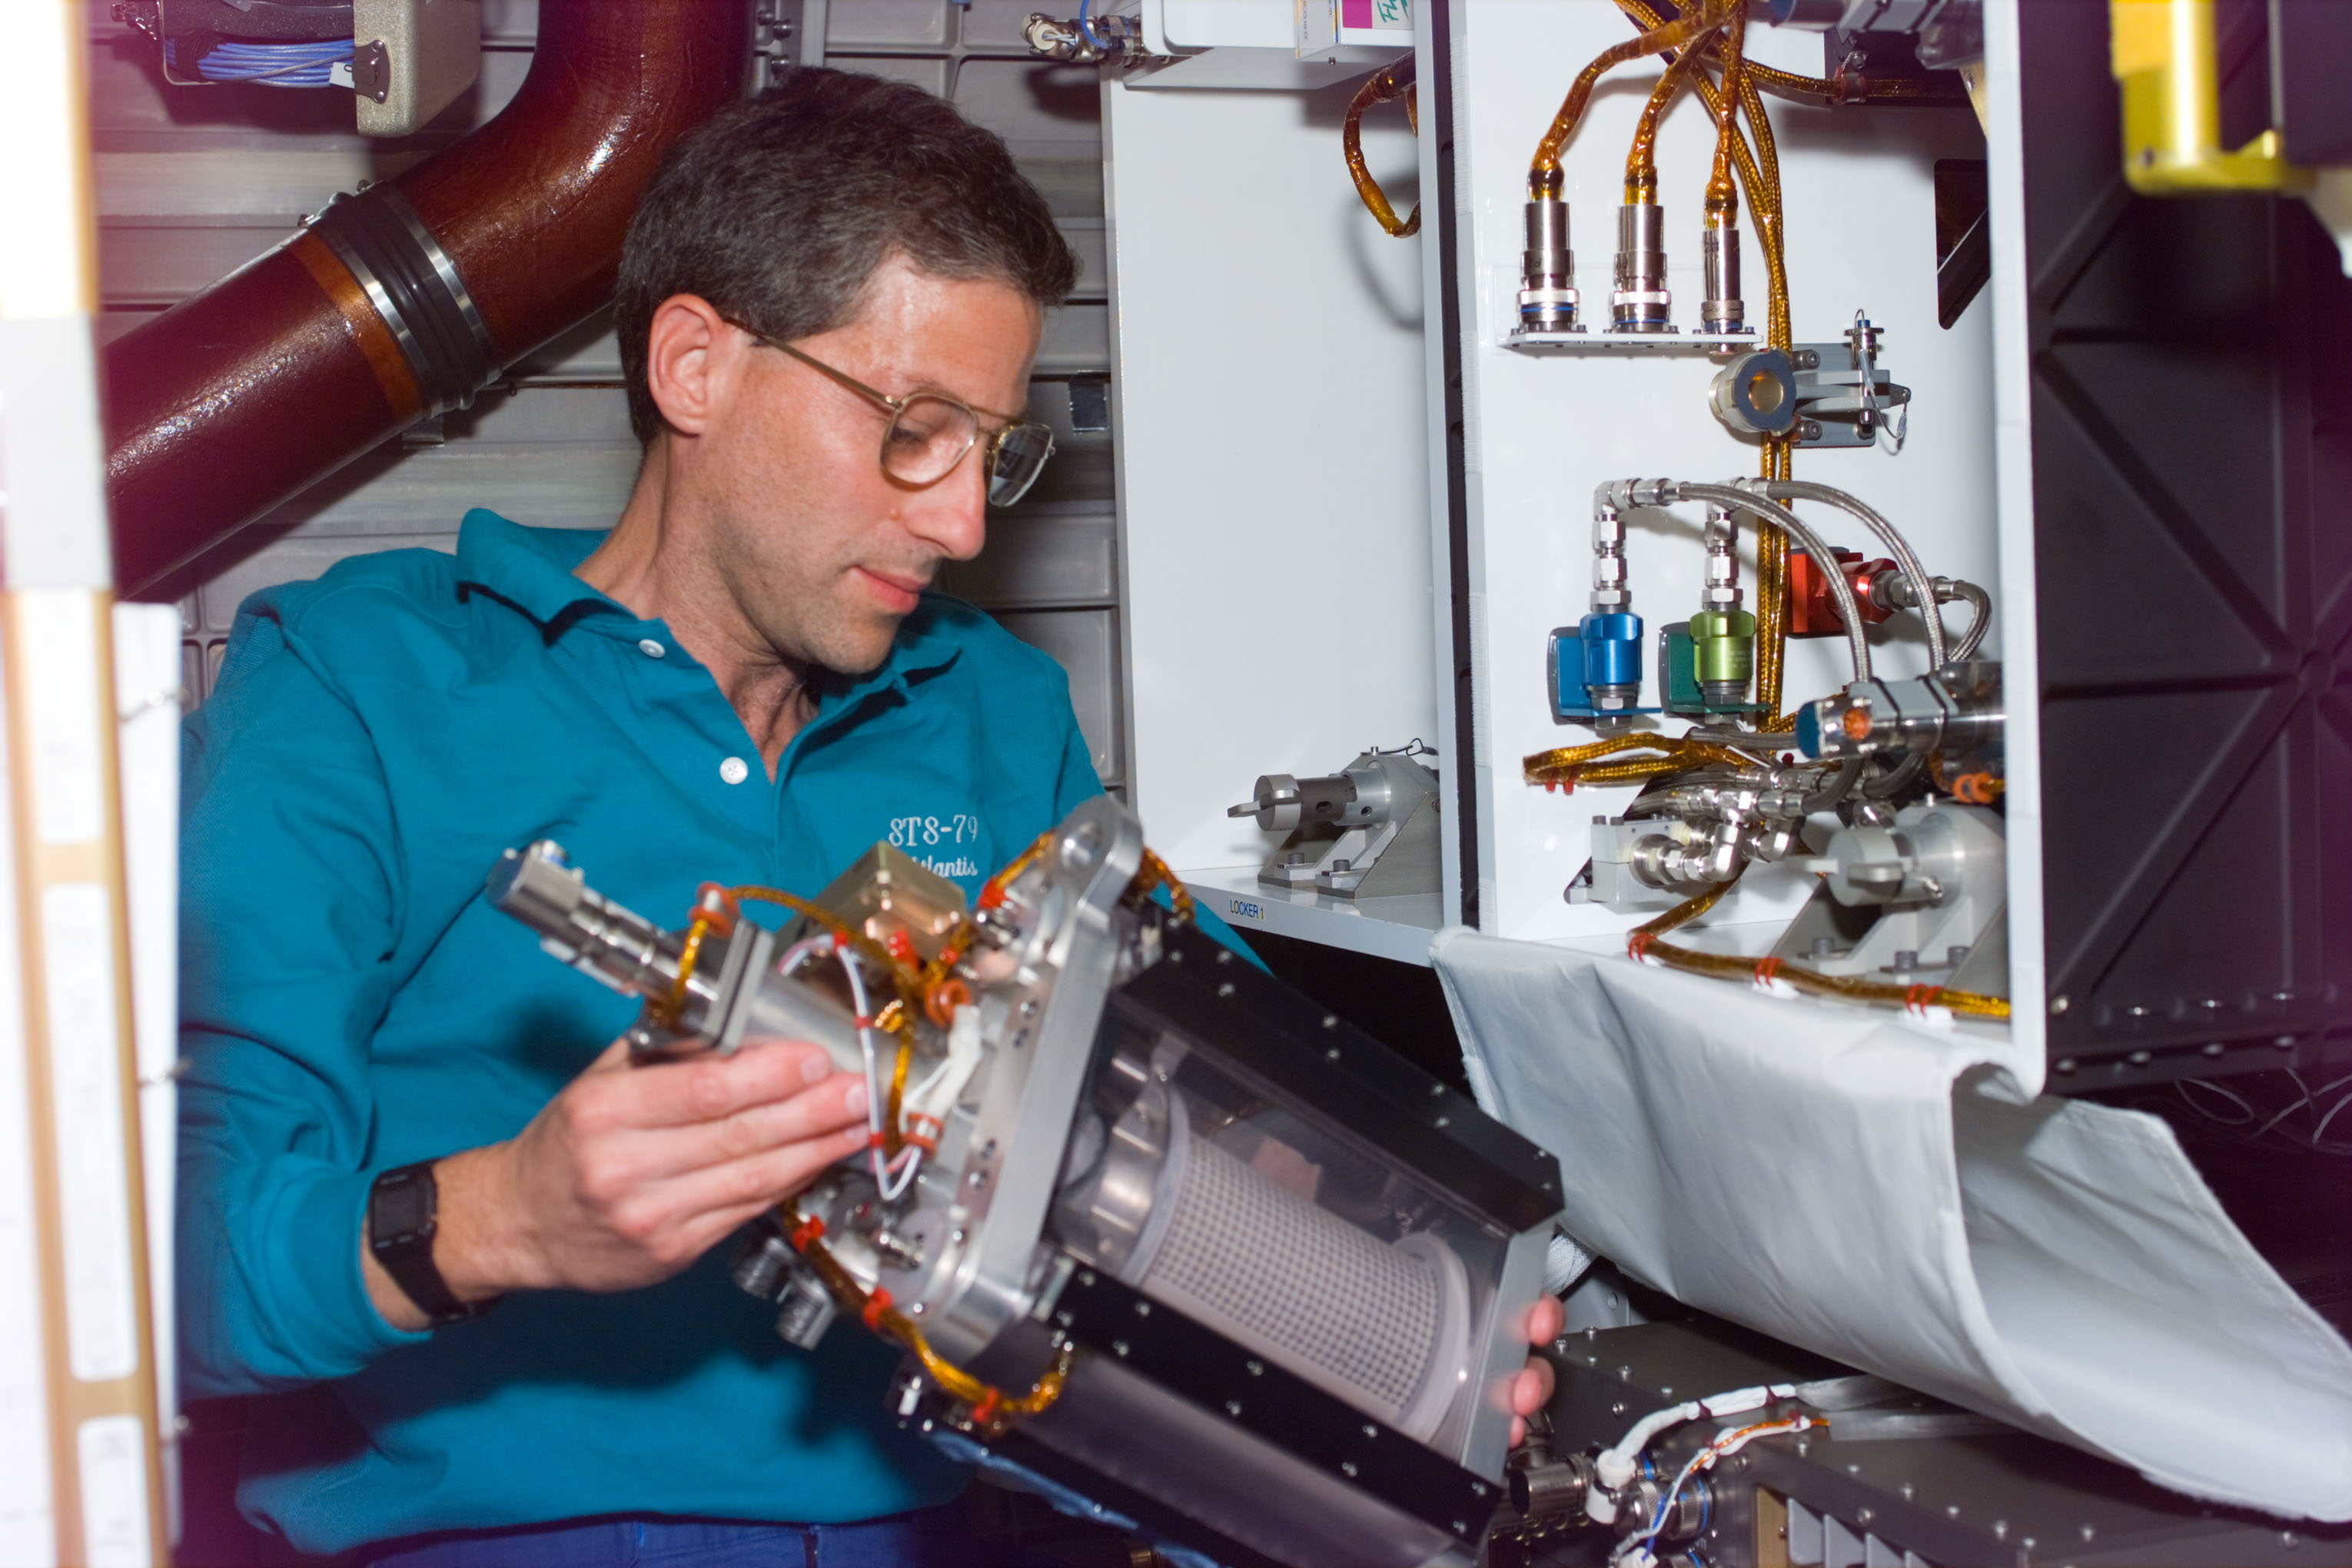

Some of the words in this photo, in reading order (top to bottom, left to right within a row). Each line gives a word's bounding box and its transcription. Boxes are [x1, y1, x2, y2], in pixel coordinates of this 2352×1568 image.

[889, 815, 978, 846] STS-79
[912, 855, 978, 878] lantis
[1230, 899, 1259, 919] LOCKER
